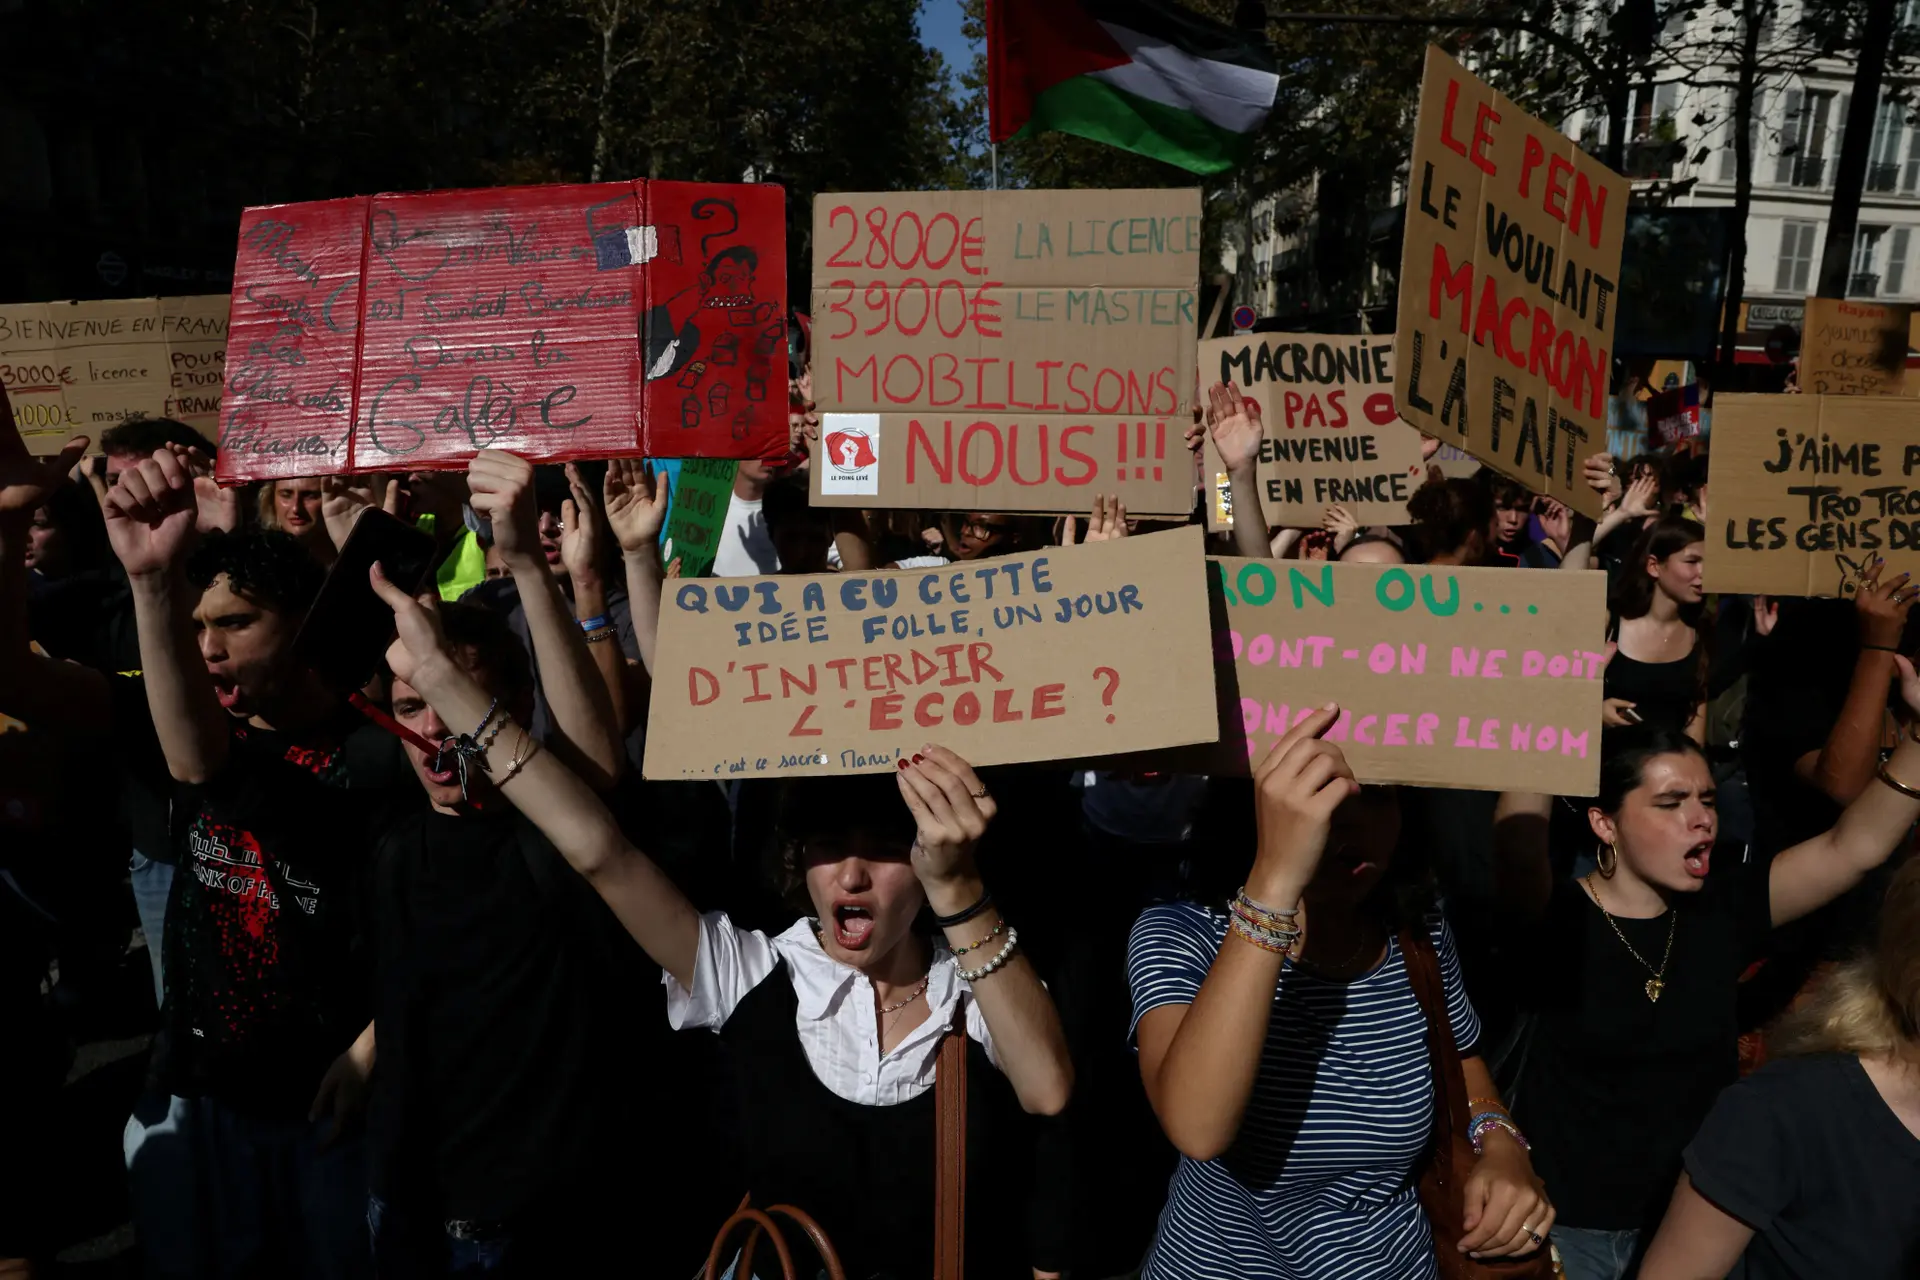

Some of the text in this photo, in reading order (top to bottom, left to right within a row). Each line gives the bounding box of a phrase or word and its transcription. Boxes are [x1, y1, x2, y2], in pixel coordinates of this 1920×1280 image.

[1440, 78, 1607, 249] LE PEN
[826, 205, 1199, 275] 2800€ LA LICENCE
[1420, 161, 1613, 331] LE VOULAIT
[0, 317, 123, 341] BIENVENUE
[133, 317, 156, 333] EN
[830, 278, 1195, 339] 3900€ LE MASTER
[1429, 242, 1607, 419] MACRON
[1, 361, 149, 385] 3000€ licence
[171, 351, 226, 368] POUR
[836, 353, 1178, 415] MOBILISONS
[92, 408, 150, 422] master
[1284, 390, 1348, 429] PAS
[1409, 330, 1588, 490] L'A FAIT
[906, 420, 1166, 486] NOUS !!!
[1259, 435, 1377, 463] ENVENUE
[1267, 479, 1302, 504] EN
[1787, 486, 1861, 522] TRO
[1726, 517, 1788, 550] LES
[1796, 518, 1881, 552] GENS
[676, 557, 1053, 614] QUI A EU CETTE
[734, 584, 1143, 647] IDÉE FOLLE, UN JOUR
[688, 642, 1004, 706] D'INTERDIR
[1450, 646, 1507, 678] NE
[788, 666, 1120, 738] L'ÉCOLE ?
[1454, 716, 1500, 749] LE
[1510, 723, 1588, 759] NOM
[714, 757, 746, 775] c'est
[778, 748, 822, 769] sacré
[227, 876, 256, 896] OF
